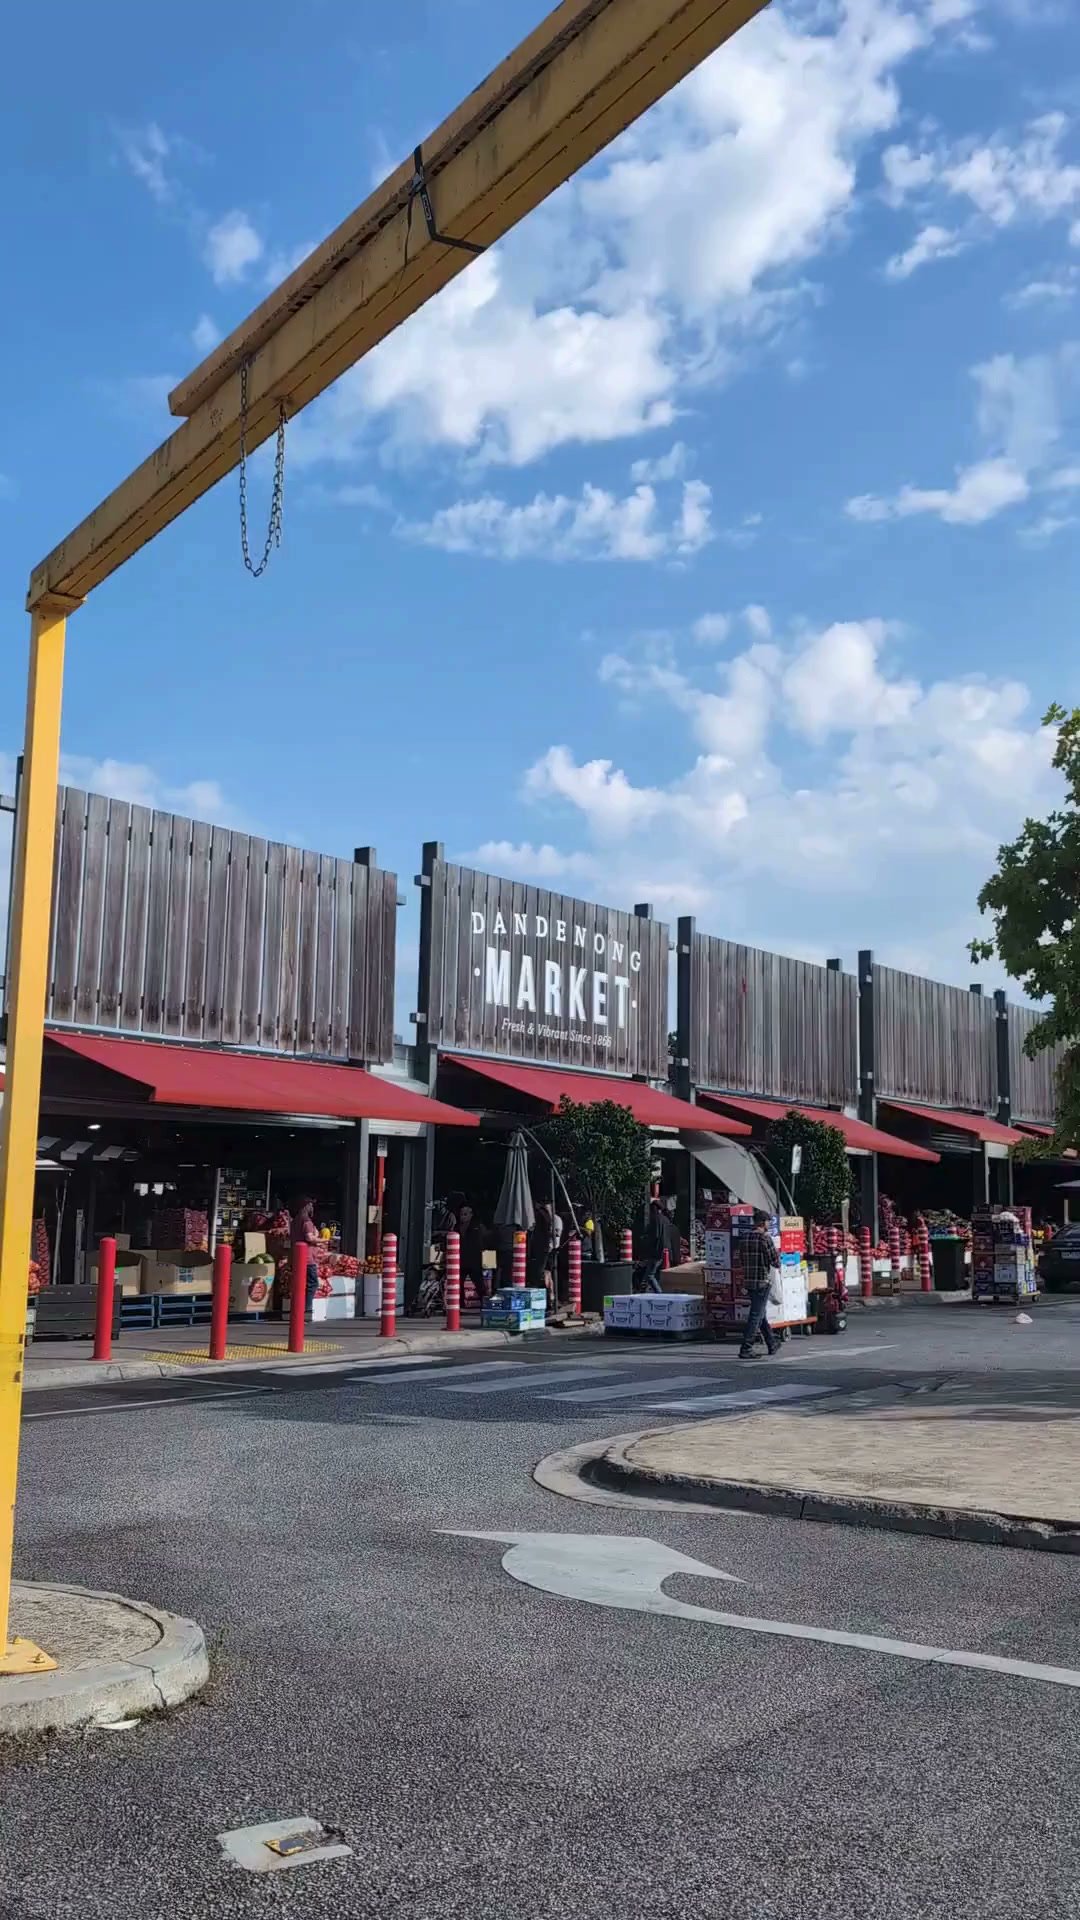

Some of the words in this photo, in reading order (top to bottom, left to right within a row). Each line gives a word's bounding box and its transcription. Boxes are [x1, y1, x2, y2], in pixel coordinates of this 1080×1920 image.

[472, 912, 641, 972] DANDENONG
[486, 947, 629, 1028] MARKET
[501, 1018, 526, 1033] Fresh
[527, 1023, 535, 1034] &
[537, 1024, 569, 1040] Vibrant
[569, 1030, 592, 1044] Since
